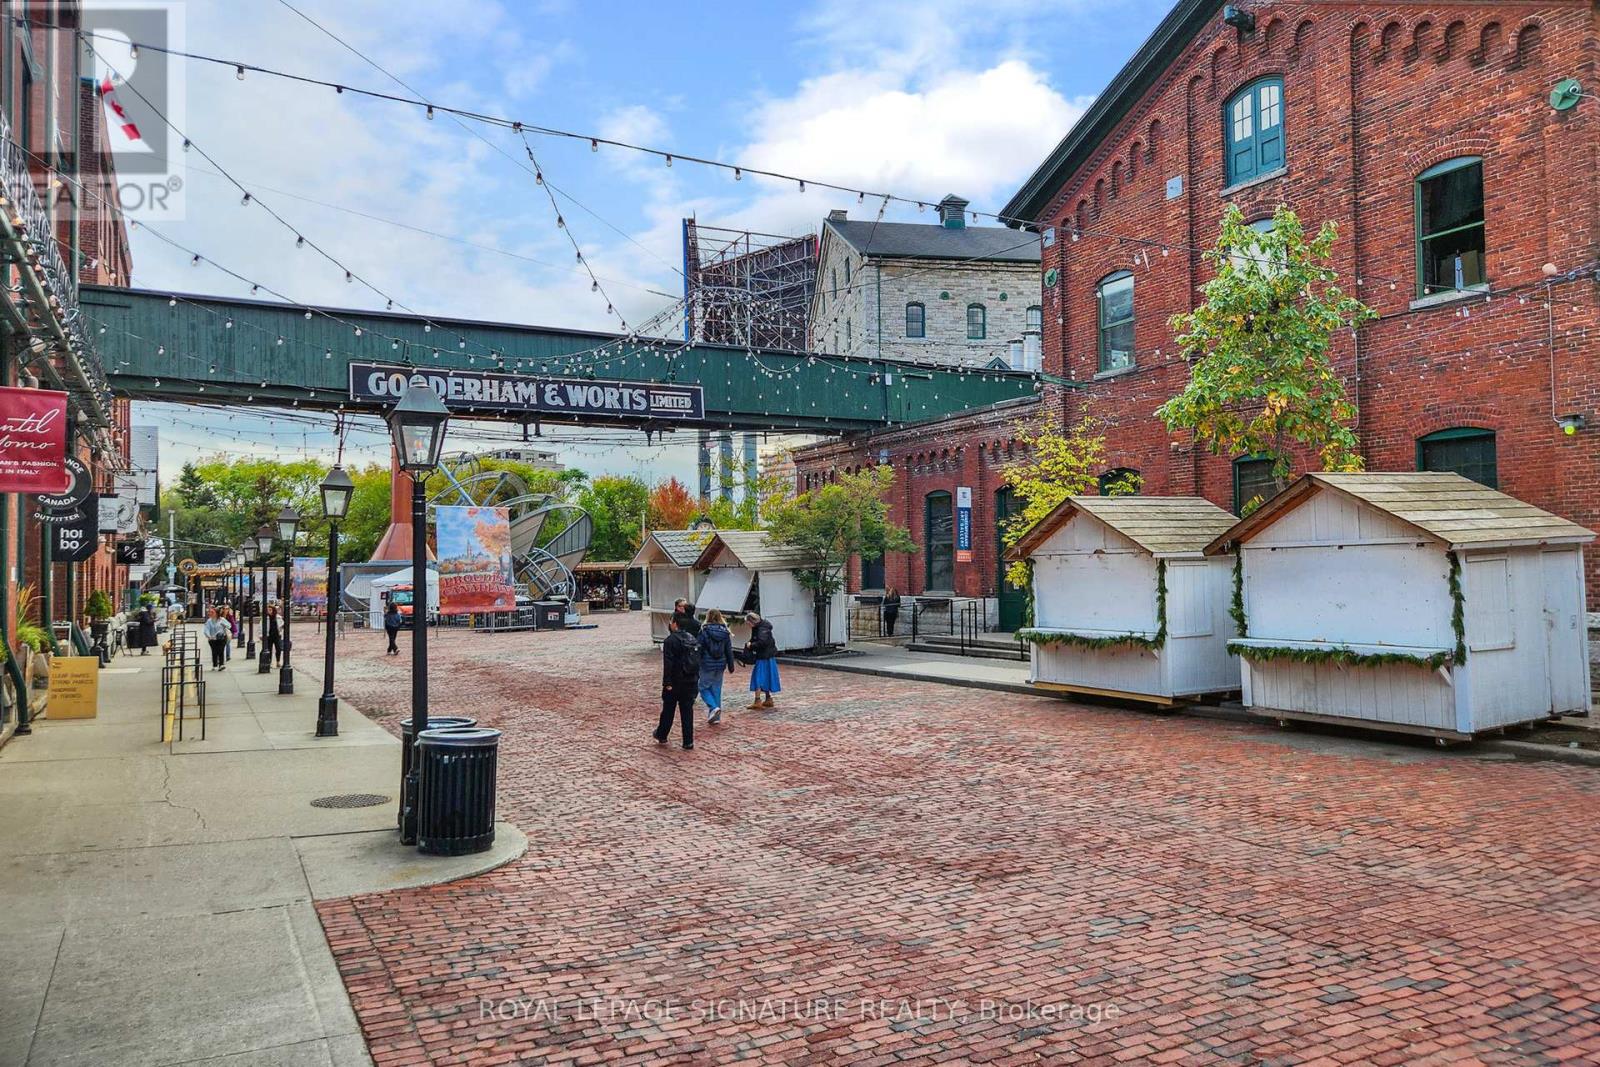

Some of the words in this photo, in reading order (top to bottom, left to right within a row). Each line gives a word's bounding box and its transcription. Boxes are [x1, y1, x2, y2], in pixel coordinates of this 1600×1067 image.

[544, 384, 566, 407] &
[565, 385, 647, 411] WORTS
[650, 395, 692, 409] LIMITED
[38, 495, 78, 506] CANADA
[34, 512, 80, 522] OUTFITTER
[60, 540, 80, 550] bo
